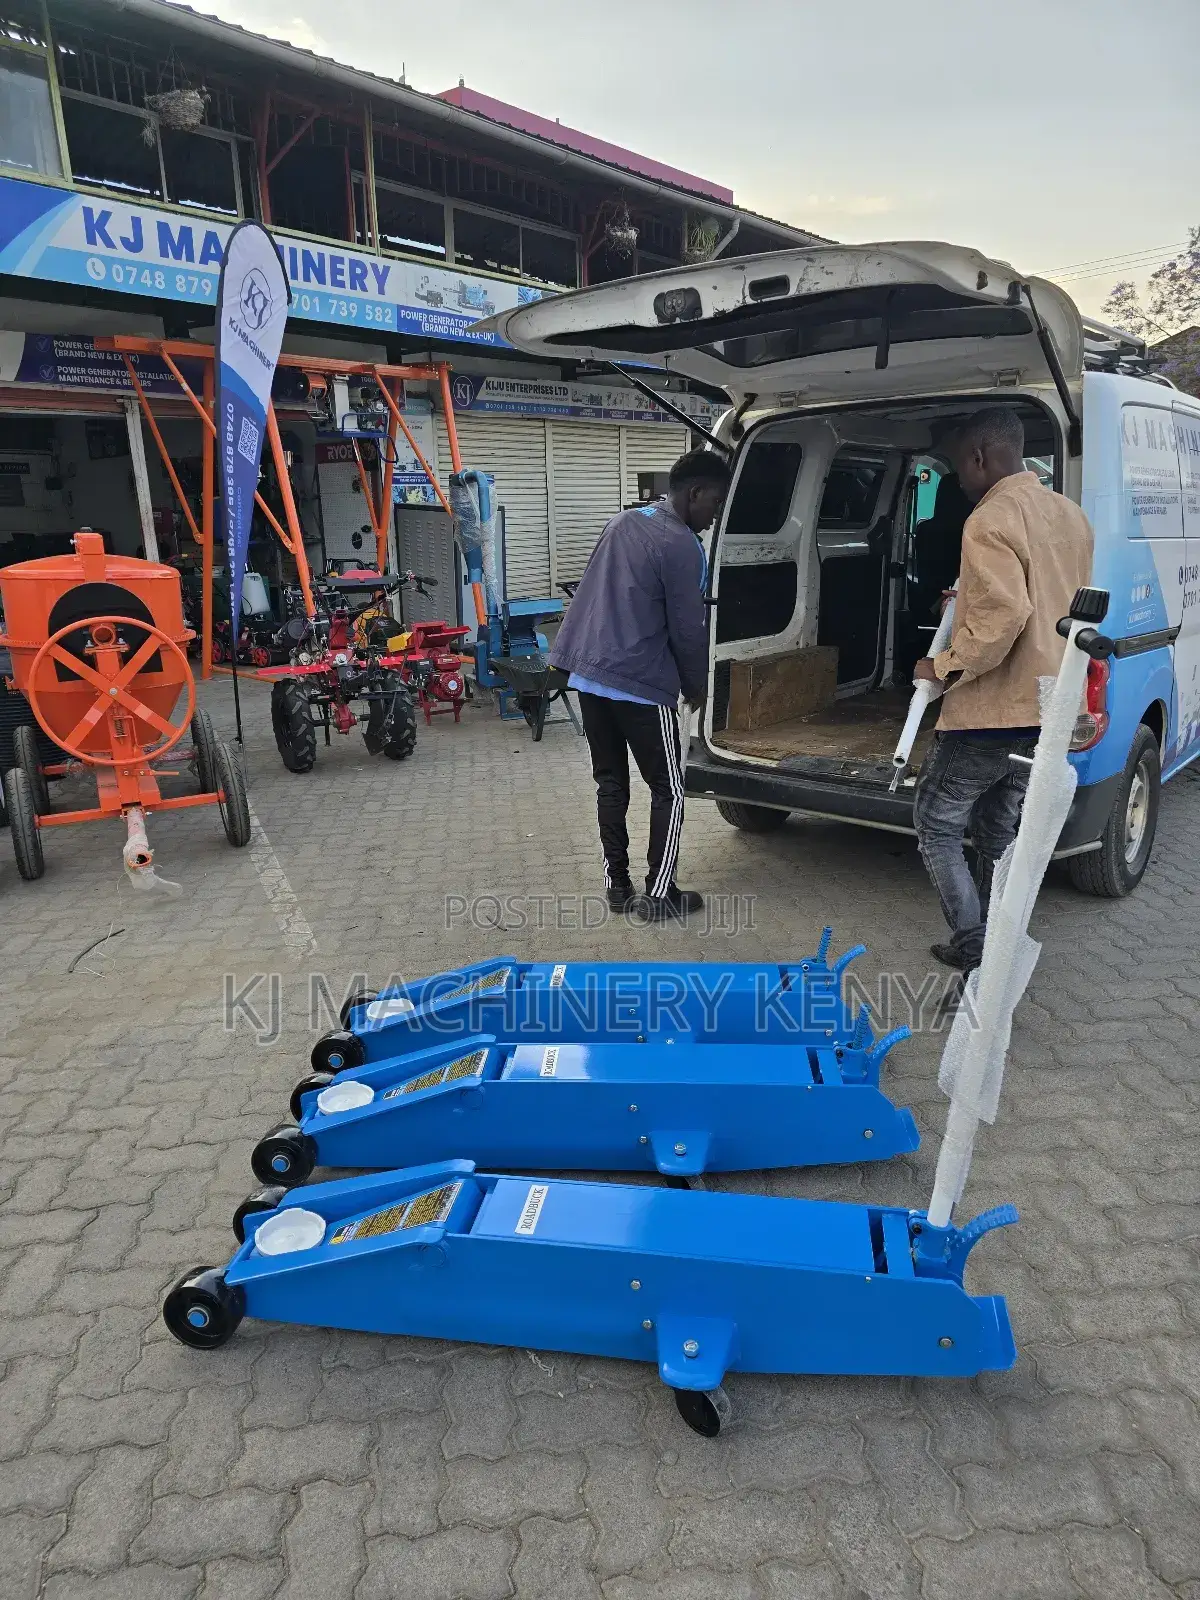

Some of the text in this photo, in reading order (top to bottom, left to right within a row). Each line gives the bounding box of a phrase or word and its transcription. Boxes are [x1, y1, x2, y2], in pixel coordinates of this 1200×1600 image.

[82, 205, 391, 297] KJ MAINERY
[112, 264, 393, 324] 0748 879 701 739 582
[400, 309, 428, 323] POWER
[229, 316, 238, 333] KJ
[421, 321, 449, 334] (BRAND
[450, 327, 465, 337] NEW
[53, 340, 83, 350] POWER
[54, 347, 86, 358] (BRAND
[87, 352, 105, 360] NEW
[57, 365, 86, 375] POWER
[59, 374, 115, 385] MAINTENANCE
[456, 383, 471, 406] KJ
[485, 380, 505, 391] KIJU
[505, 382, 554, 395] ENTERPRISES
[554, 386, 569, 396] LTD
[1144, 418, 1200, 457] MACHIN
[520, 1187, 545, 1230] ROADBUCK
